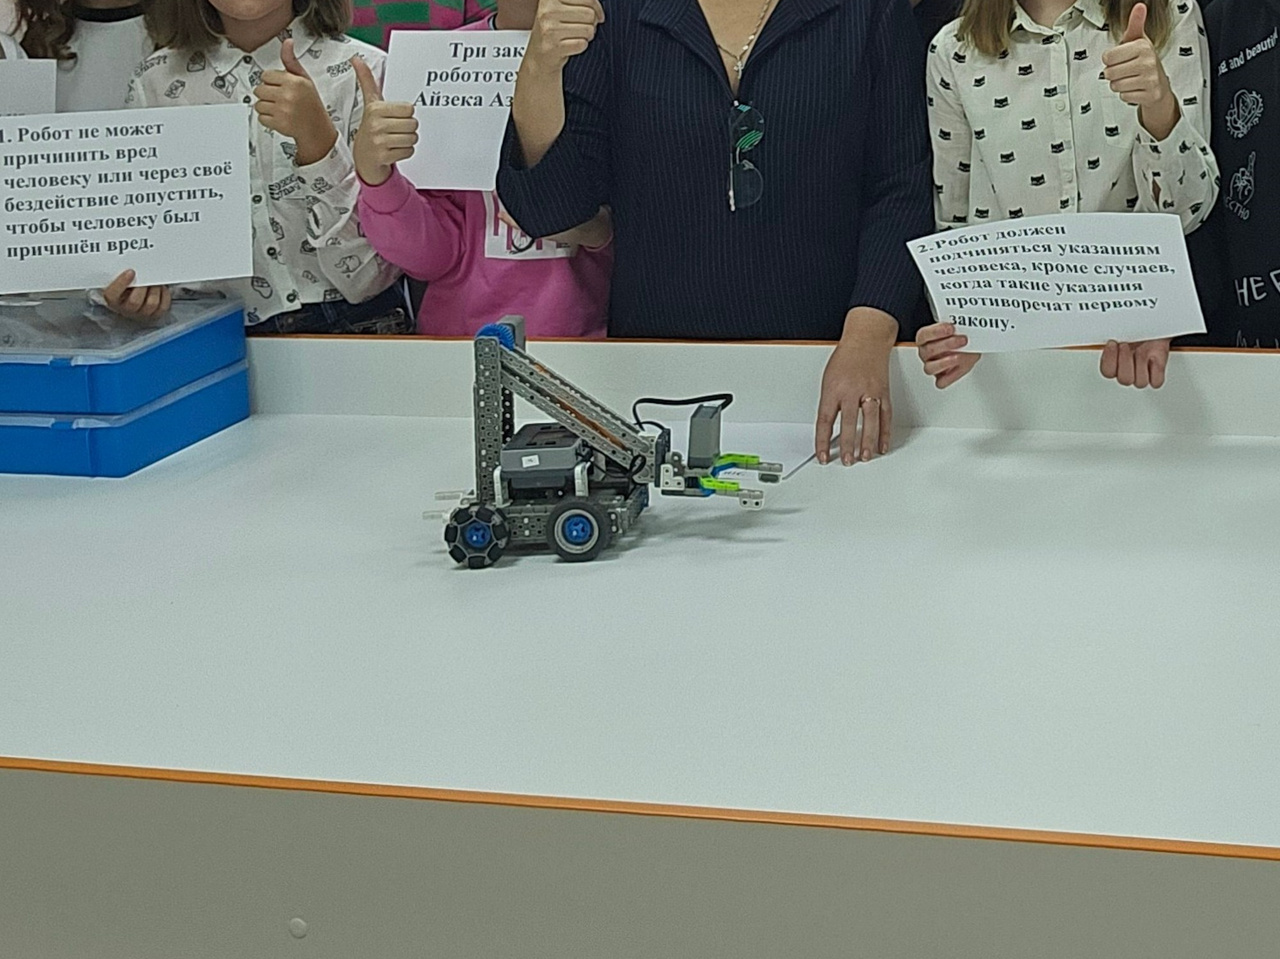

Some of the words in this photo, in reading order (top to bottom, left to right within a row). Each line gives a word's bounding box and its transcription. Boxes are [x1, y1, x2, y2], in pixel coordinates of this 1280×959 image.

[449, 43, 486, 62] Три
[493, 45, 525, 58] зак
[1228, 51, 1245, 70] and
[413, 90, 483, 107] Айзека
[18, 126, 73, 142] Робот
[79, 128, 99, 139] не
[106, 124, 164, 137] может
[4, 150, 110, 169] причинить
[116, 147, 158, 163] вред
[4, 174, 91, 189] человеку
[98, 171, 132, 183] или
[139, 167, 187, 183] через
[193, 161, 232, 177] своё
[5, 194, 118, 212] бездействие
[124, 188, 223, 206] допустить,
[6, 218, 65, 235] чтобы
[72, 215, 157, 231] человеку
[163, 209, 199, 224] был
[7, 239, 100, 261] причинён
[107, 238, 154, 255] вред.
[918, 245, 933, 253] 2.
[935, 233, 990, 249] Робот
[996, 226, 1066, 240] должен
[929, 240, 1052, 266] подчиняться
[1058, 244, 1160, 256] указаниям
[934, 262, 1027, 275] человека,
[1032, 262, 1088, 275] кроме
[1094, 265, 1175, 278] случаев,
[940, 280, 992, 290] когда
[996, 280, 1050, 291] такие
[1055, 283, 1143, 296] указания
[1235, 277, 1267, 306] НЕ
[946, 298, 1073, 313] противоречат
[1079, 298, 1158, 312] первому
[949, 315, 1015, 332] закону.
